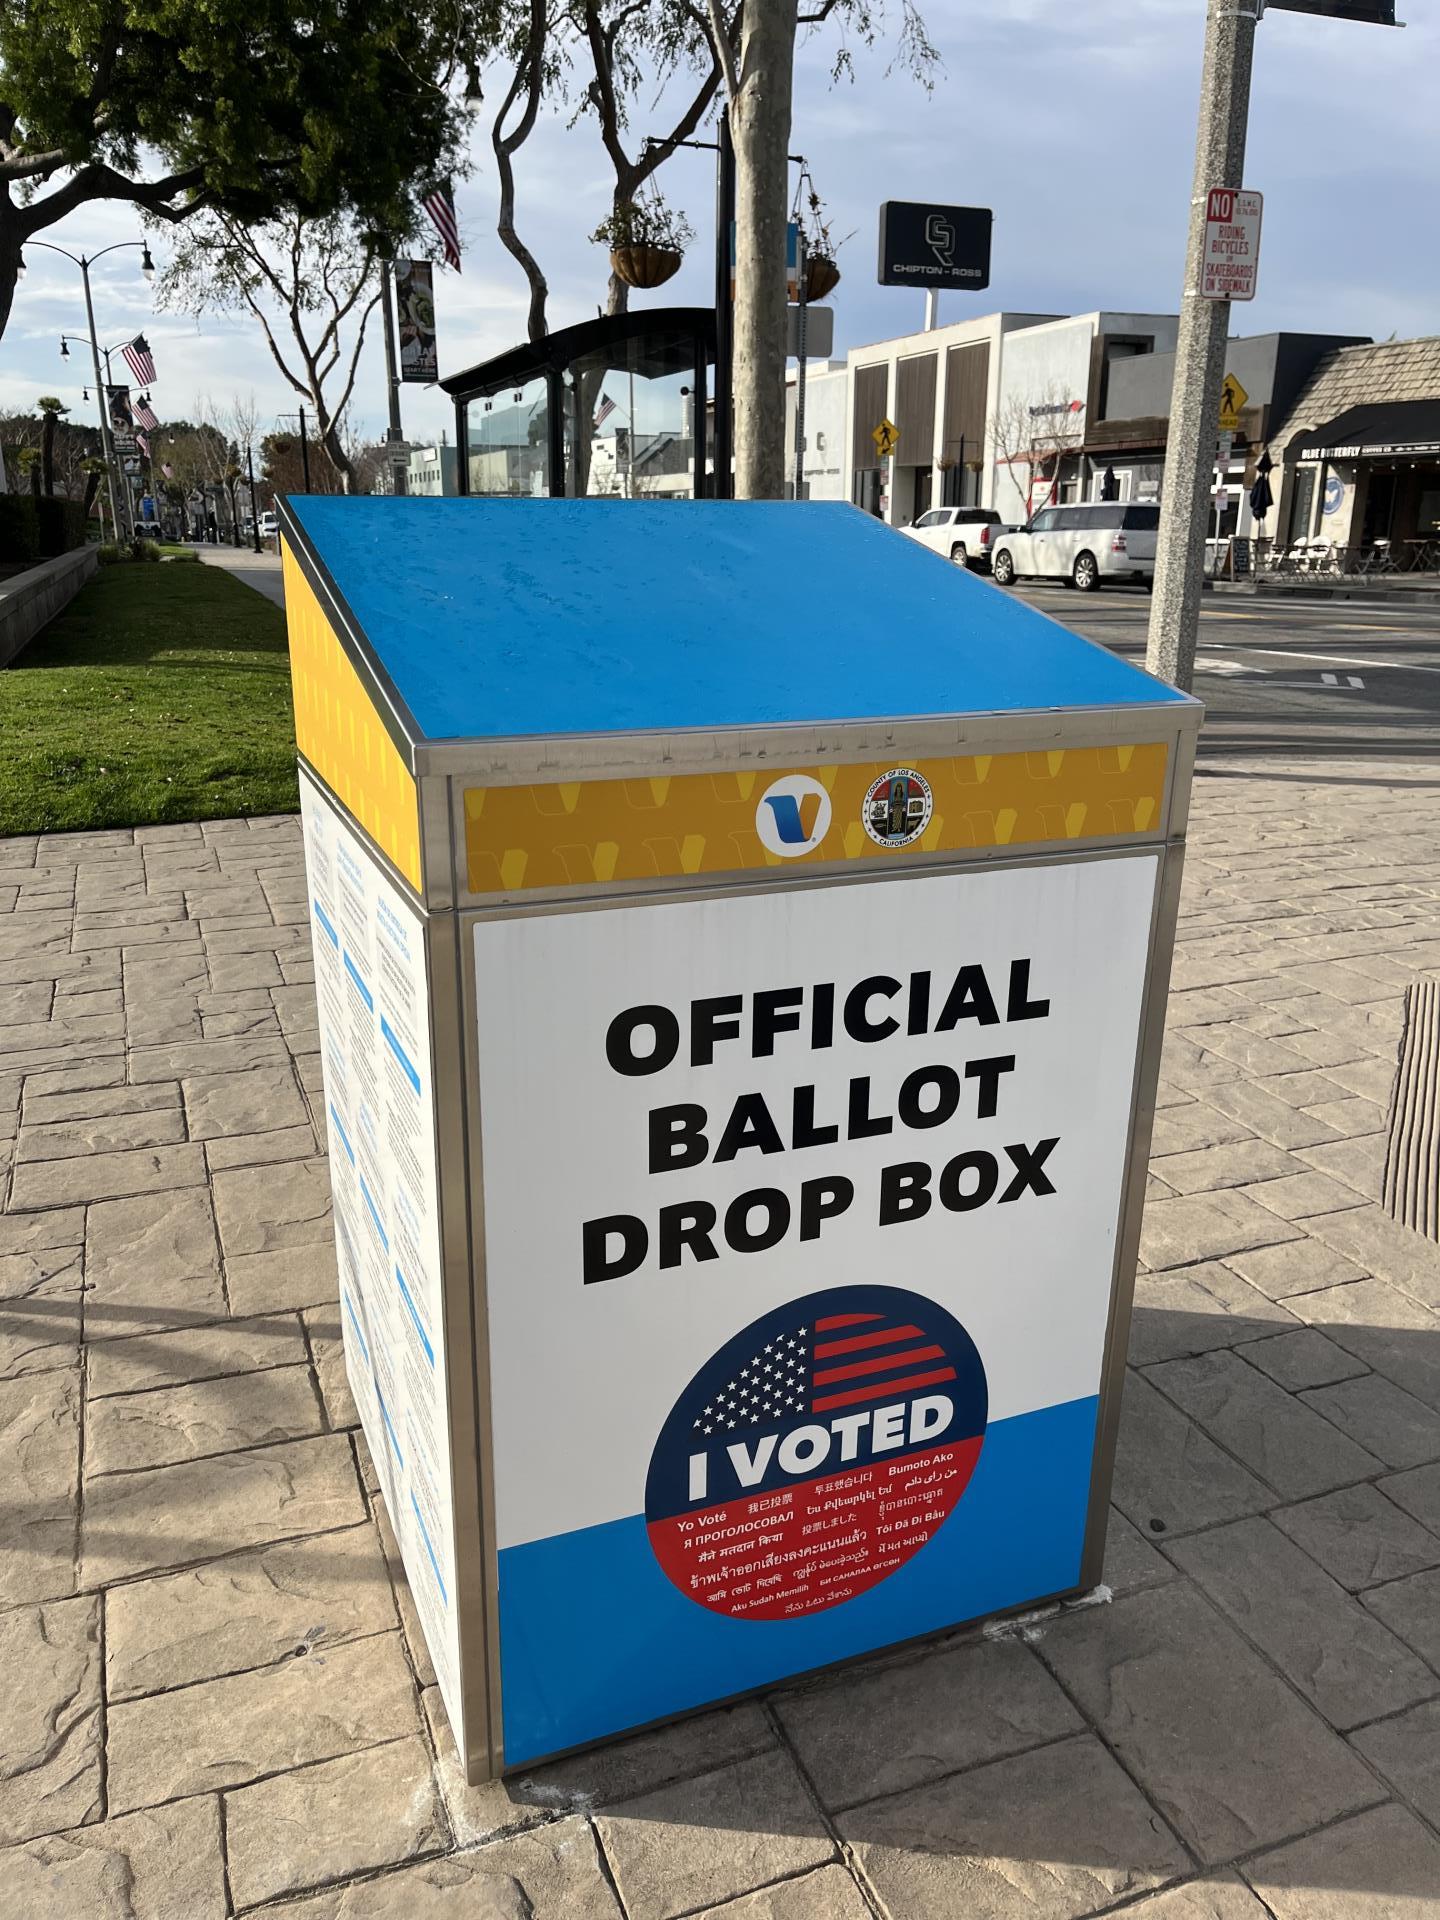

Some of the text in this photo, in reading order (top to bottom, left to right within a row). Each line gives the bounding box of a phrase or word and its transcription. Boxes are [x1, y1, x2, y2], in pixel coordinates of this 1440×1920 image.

[1211, 194, 1231, 218] NO
[1218, 225, 1246, 240] RIDING
[1211, 240, 1249, 255] BICYCLES
[892, 264, 943, 275] CHIPTON
[951, 268, 982, 278] ROSS
[1206, 263, 1253, 279] SKATEBOARDS
[1205, 278, 1250, 293] ON SIDEWALK
[1301, 448, 1320, 460] BLUE
[867, 769, 930, 798] COUNTY OF LOS ANGELES
[879, 835, 914, 848] CALIFORNIA
[605, 958, 1051, 1077] OFFICIAL
[649, 1054, 1016, 1174] BALLOT
[582, 1137, 1061, 1285] DROP BOX
[689, 1394, 954, 1501] I VOTED
[888, 1452, 954, 1477] Bumoto Ako
[815, 1471, 873, 1496] 투표했습니다
[747, 1492, 794, 1515] 我已投票
[677, 1511, 727, 1533] Yo Voté
[684, 1511, 794, 1550] Я ПРОГОЛОСОВАЛ
[801, 1512, 857, 1536] 投票しました
[876, 1523, 893, 1536] Tôi
[731, 1584, 809, 1613] Aku Sudah Memilih
